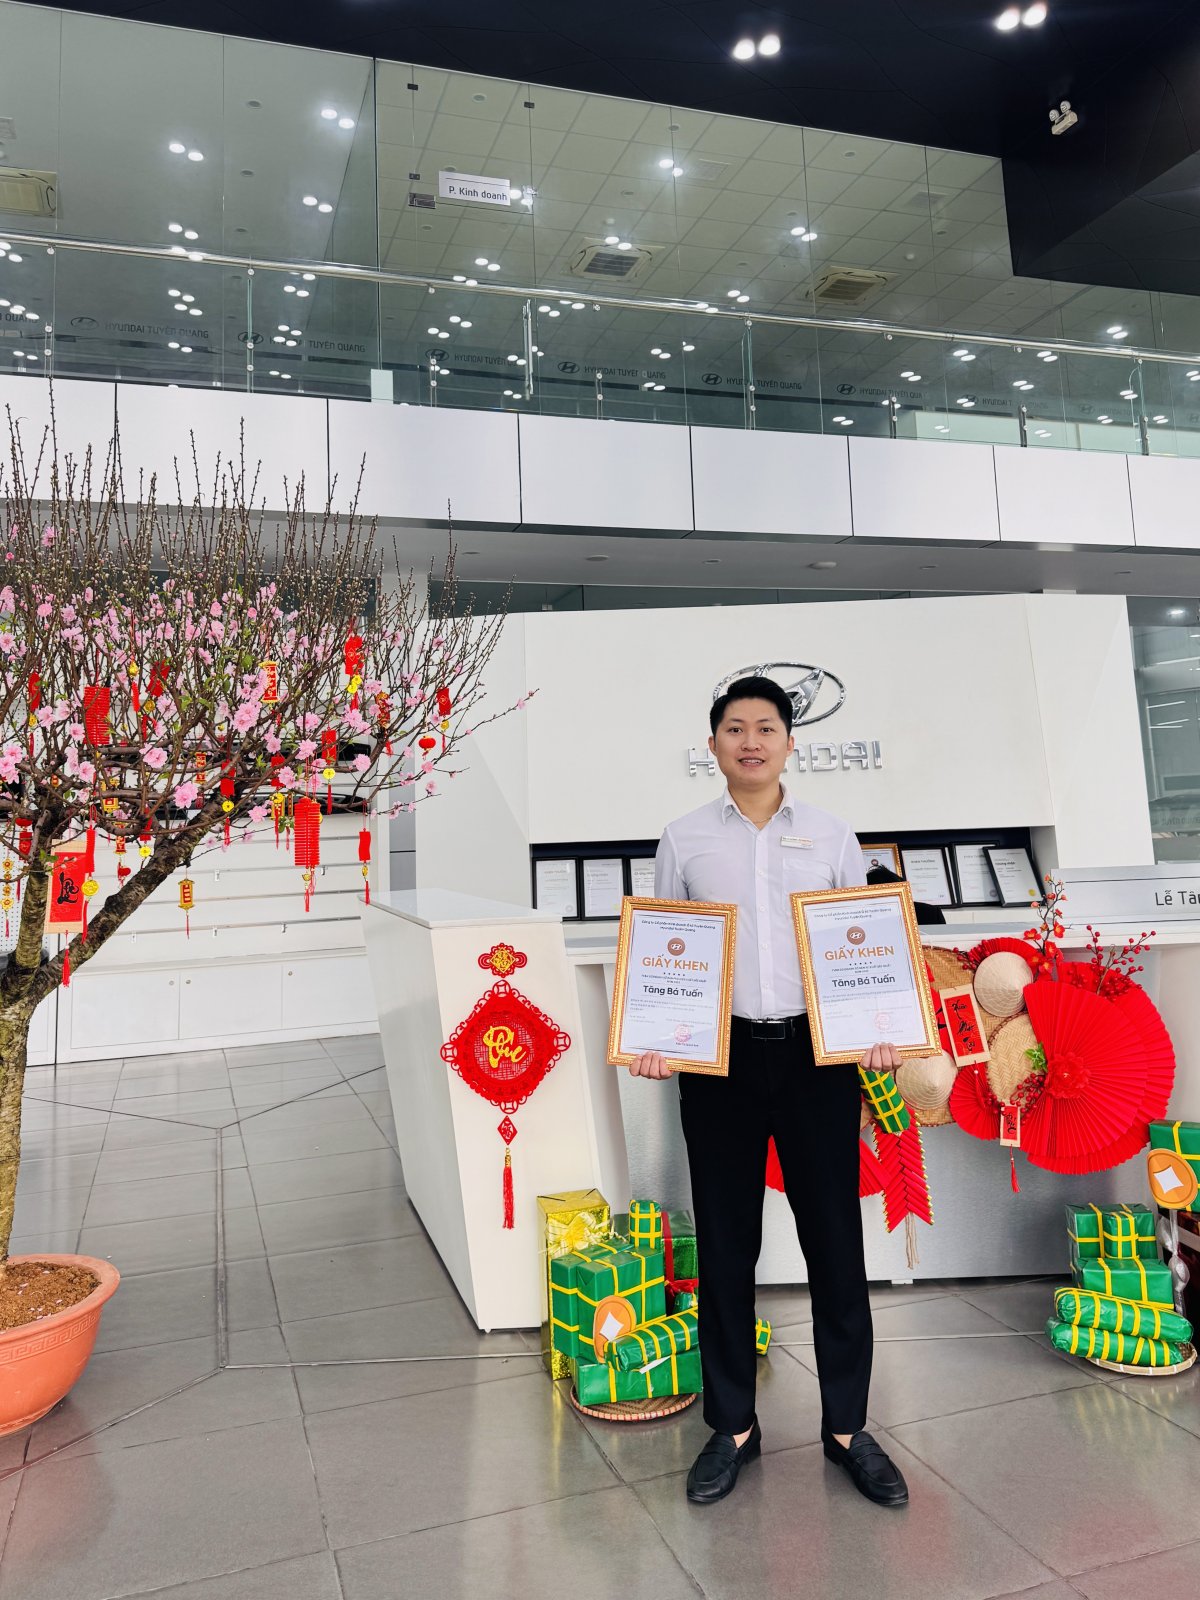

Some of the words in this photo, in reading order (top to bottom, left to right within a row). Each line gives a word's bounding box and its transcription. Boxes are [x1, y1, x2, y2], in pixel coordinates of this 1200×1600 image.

[448, 185, 456, 195] P.
[459, 187, 479, 198] Kinh
[481, 190, 508, 201] doanh
[105, 322, 145, 334] HYUNDAI
[337, 342, 366, 353] QUANG
[688, 740, 882, 777] HNDAI
[1154, 889, 1173, 906] Lễ
[824, 944, 855, 961] GIẤY
[858, 945, 895, 958] KHEN
[642, 953, 672, 969] GIẤY
[674, 959, 709, 972] KHEN
[832, 977, 856, 988] Tăng
[857, 976, 870, 985] Bá
[871, 973, 896, 984] Tuấn
[643, 985, 666, 996] Tăng
[667, 986, 679, 996] Bá
[680, 986, 703, 998] Tuấn
